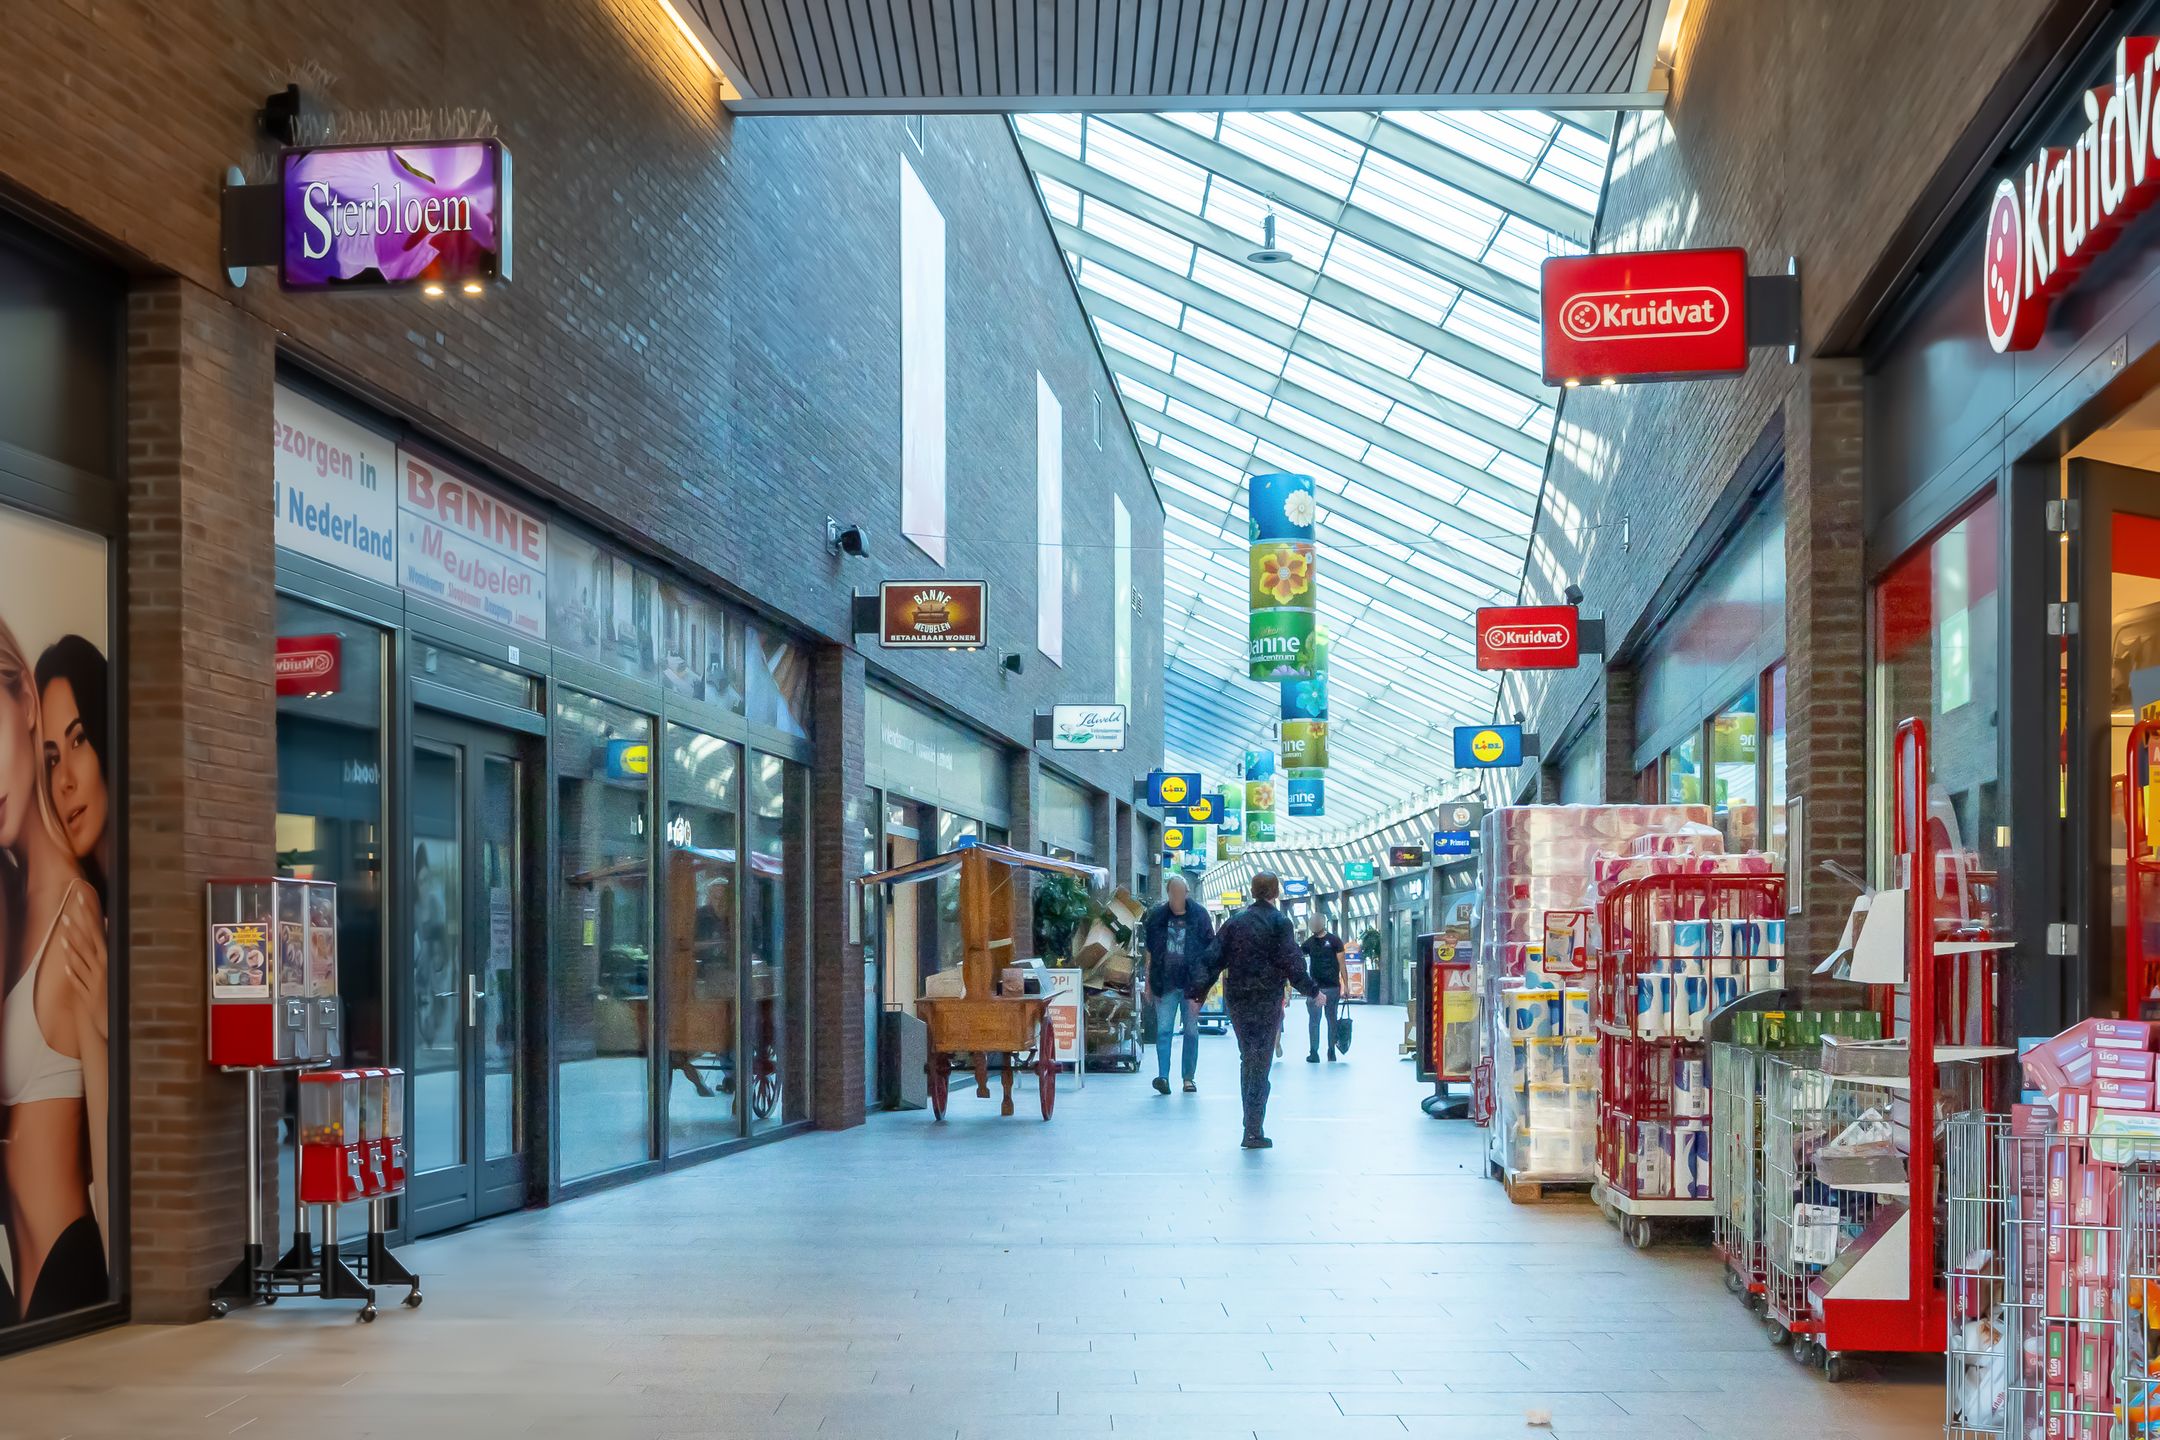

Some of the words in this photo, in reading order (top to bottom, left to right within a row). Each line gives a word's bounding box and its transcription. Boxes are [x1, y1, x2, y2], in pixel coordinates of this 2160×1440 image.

[304, 181, 472, 260] Sterbloem
[1603, 299, 1715, 328] Kruidvat
[360, 452, 377, 492] in
[289, 487, 393, 562] Nederland
[407, 460, 540, 562] BANNE
[421, 524, 531, 596] Meubelen
[913, 589, 952, 607] BANNE
[914, 622, 951, 634] MEUBELEN
[1506, 630, 1563, 645] Kruidvat
